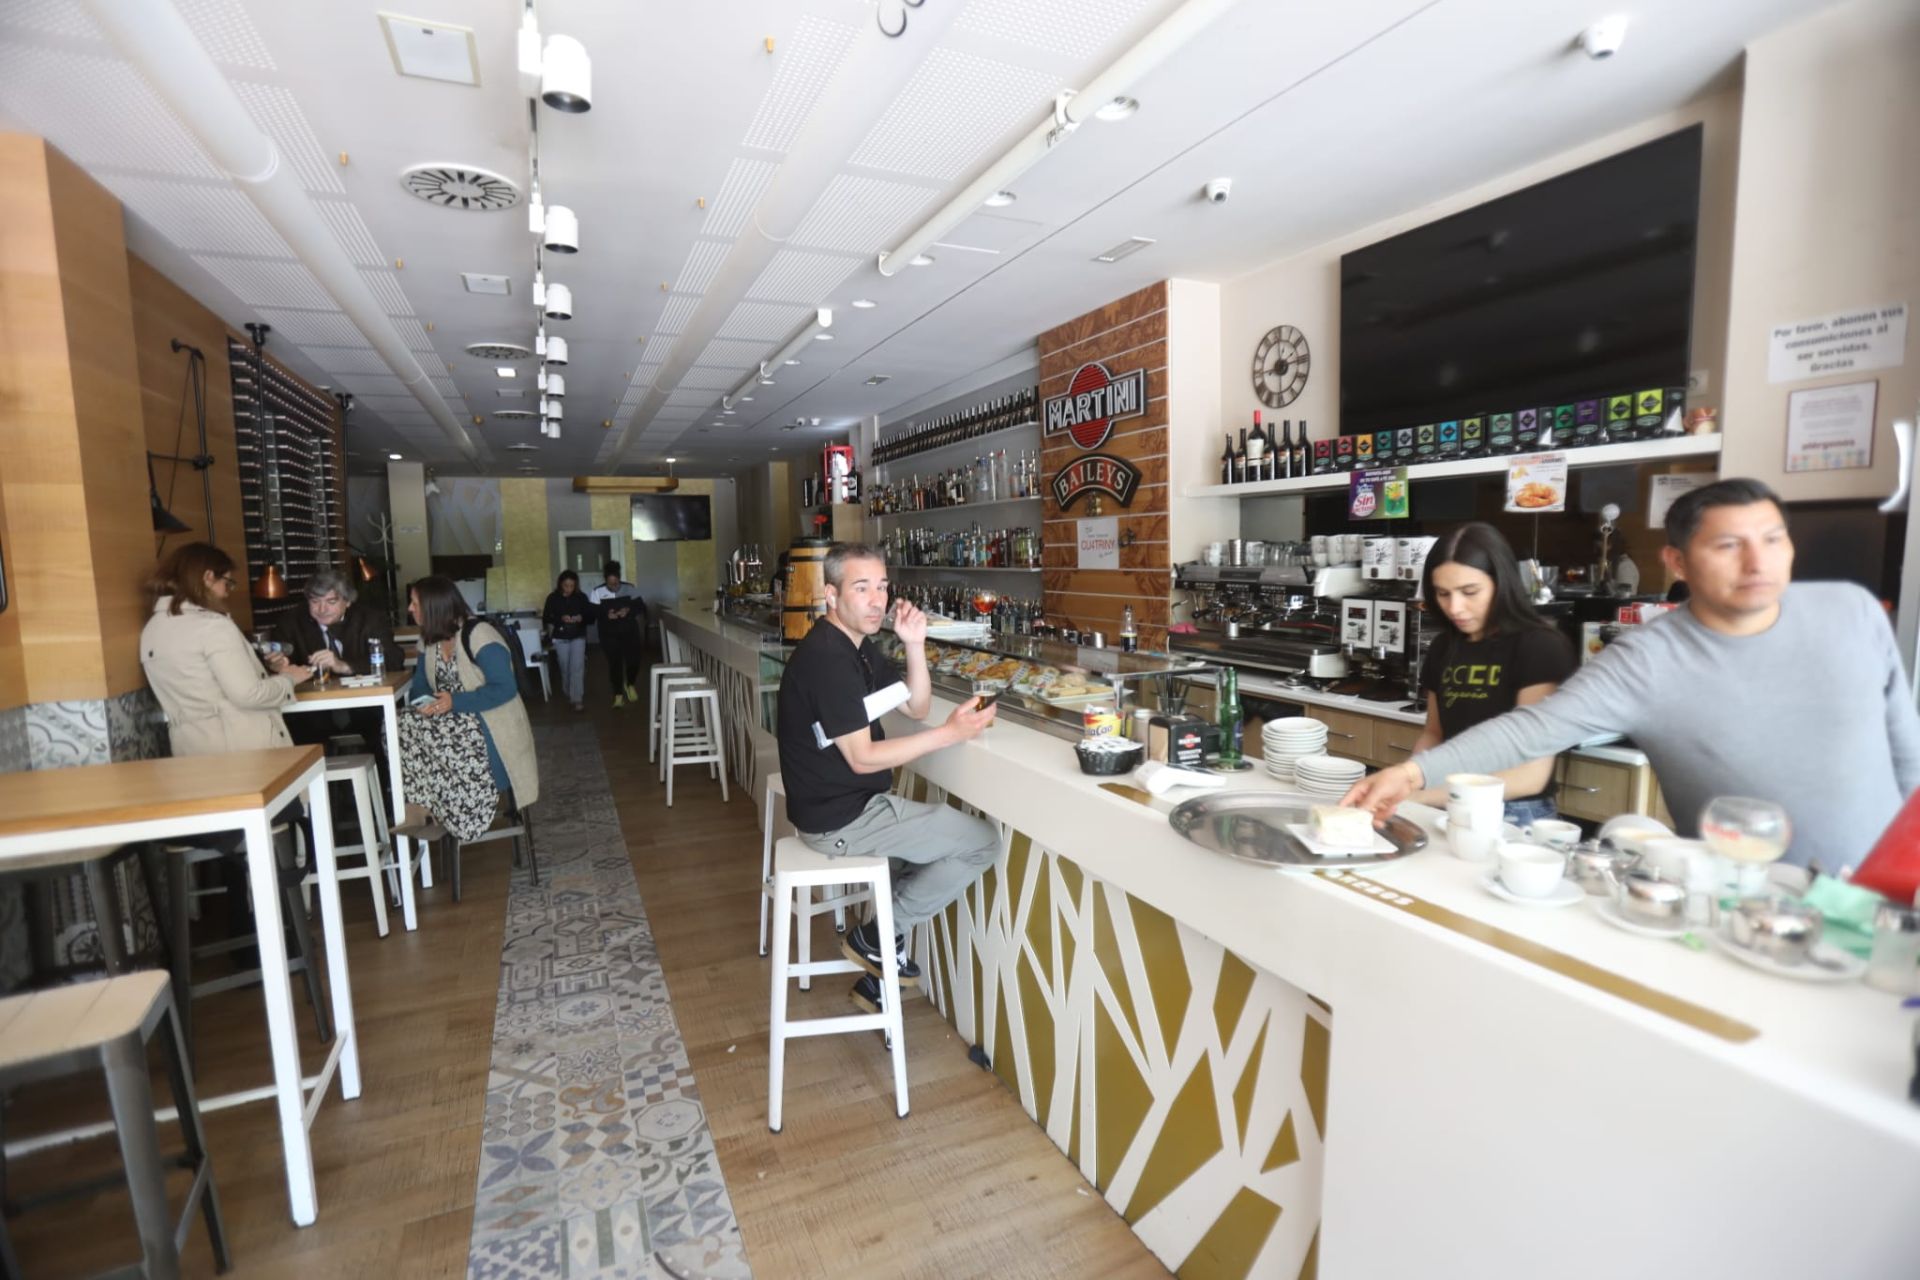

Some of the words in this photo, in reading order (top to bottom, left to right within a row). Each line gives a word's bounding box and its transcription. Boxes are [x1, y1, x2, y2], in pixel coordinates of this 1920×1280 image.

[1774, 327, 1792, 338] Por
[1832, 311, 1877, 328] abonen
[1881, 306, 1904, 318] sus
[1048, 377, 1137, 431] MARTINI
[1059, 462, 1126, 498] BAILEYS
